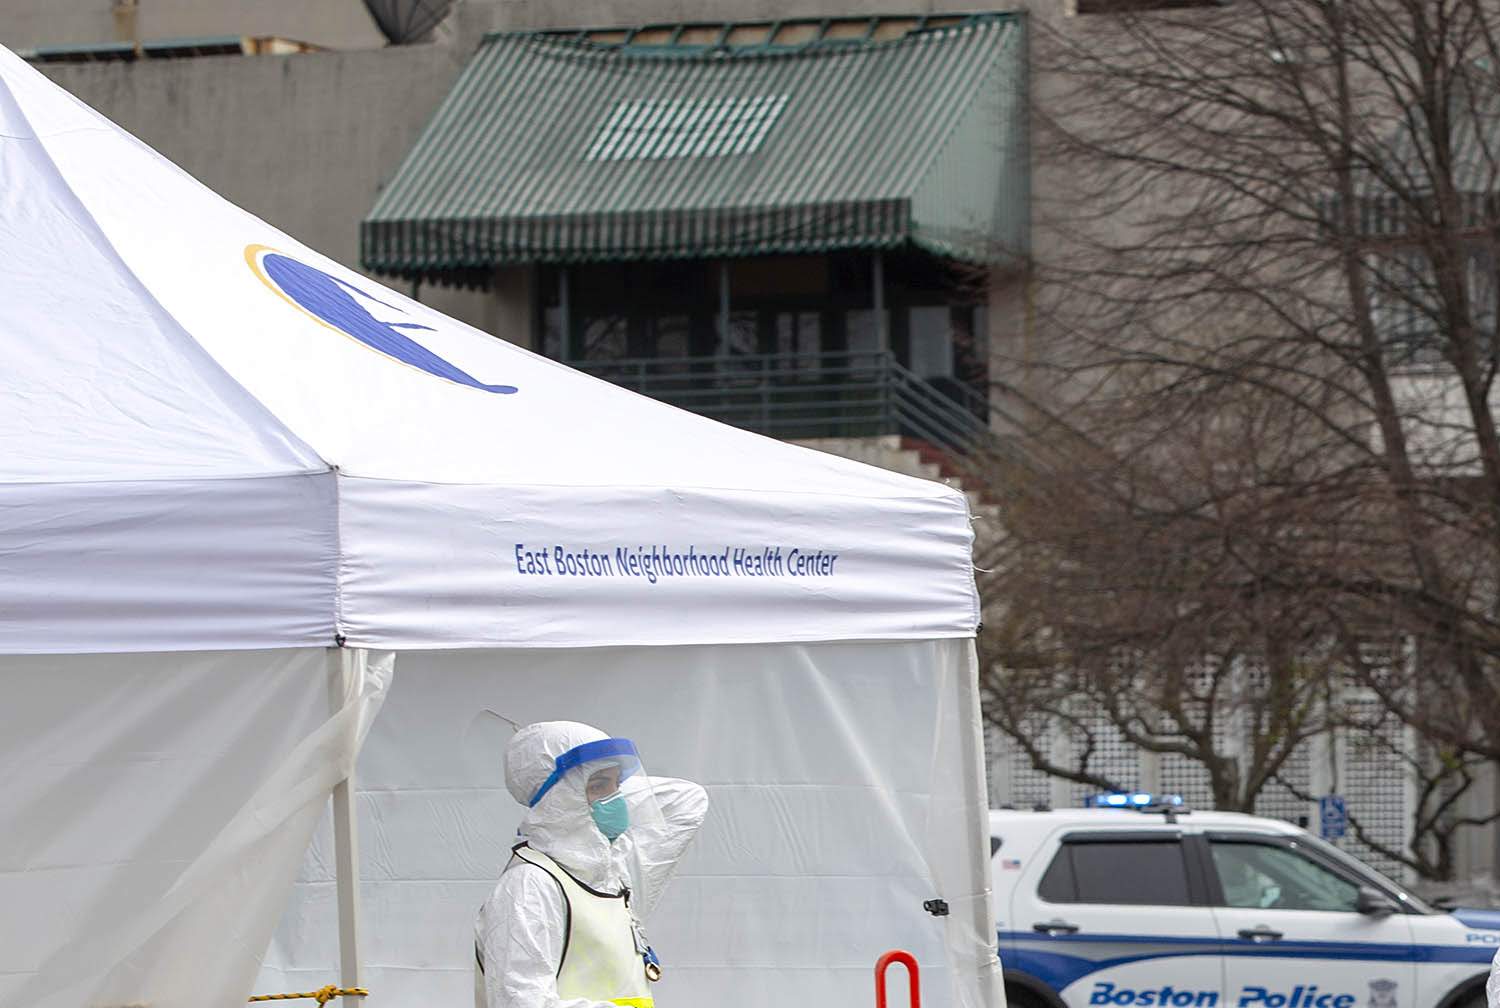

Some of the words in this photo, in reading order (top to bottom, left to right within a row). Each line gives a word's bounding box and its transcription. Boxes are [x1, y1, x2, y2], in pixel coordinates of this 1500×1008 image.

[515, 543, 552, 576] East
[554, 545, 614, 576] Boston
[615, 545, 729, 584] Neighborhood
[733, 547, 784, 577] Health
[786, 548, 839, 577] Center
[1088, 982, 1220, 1008] Boston
